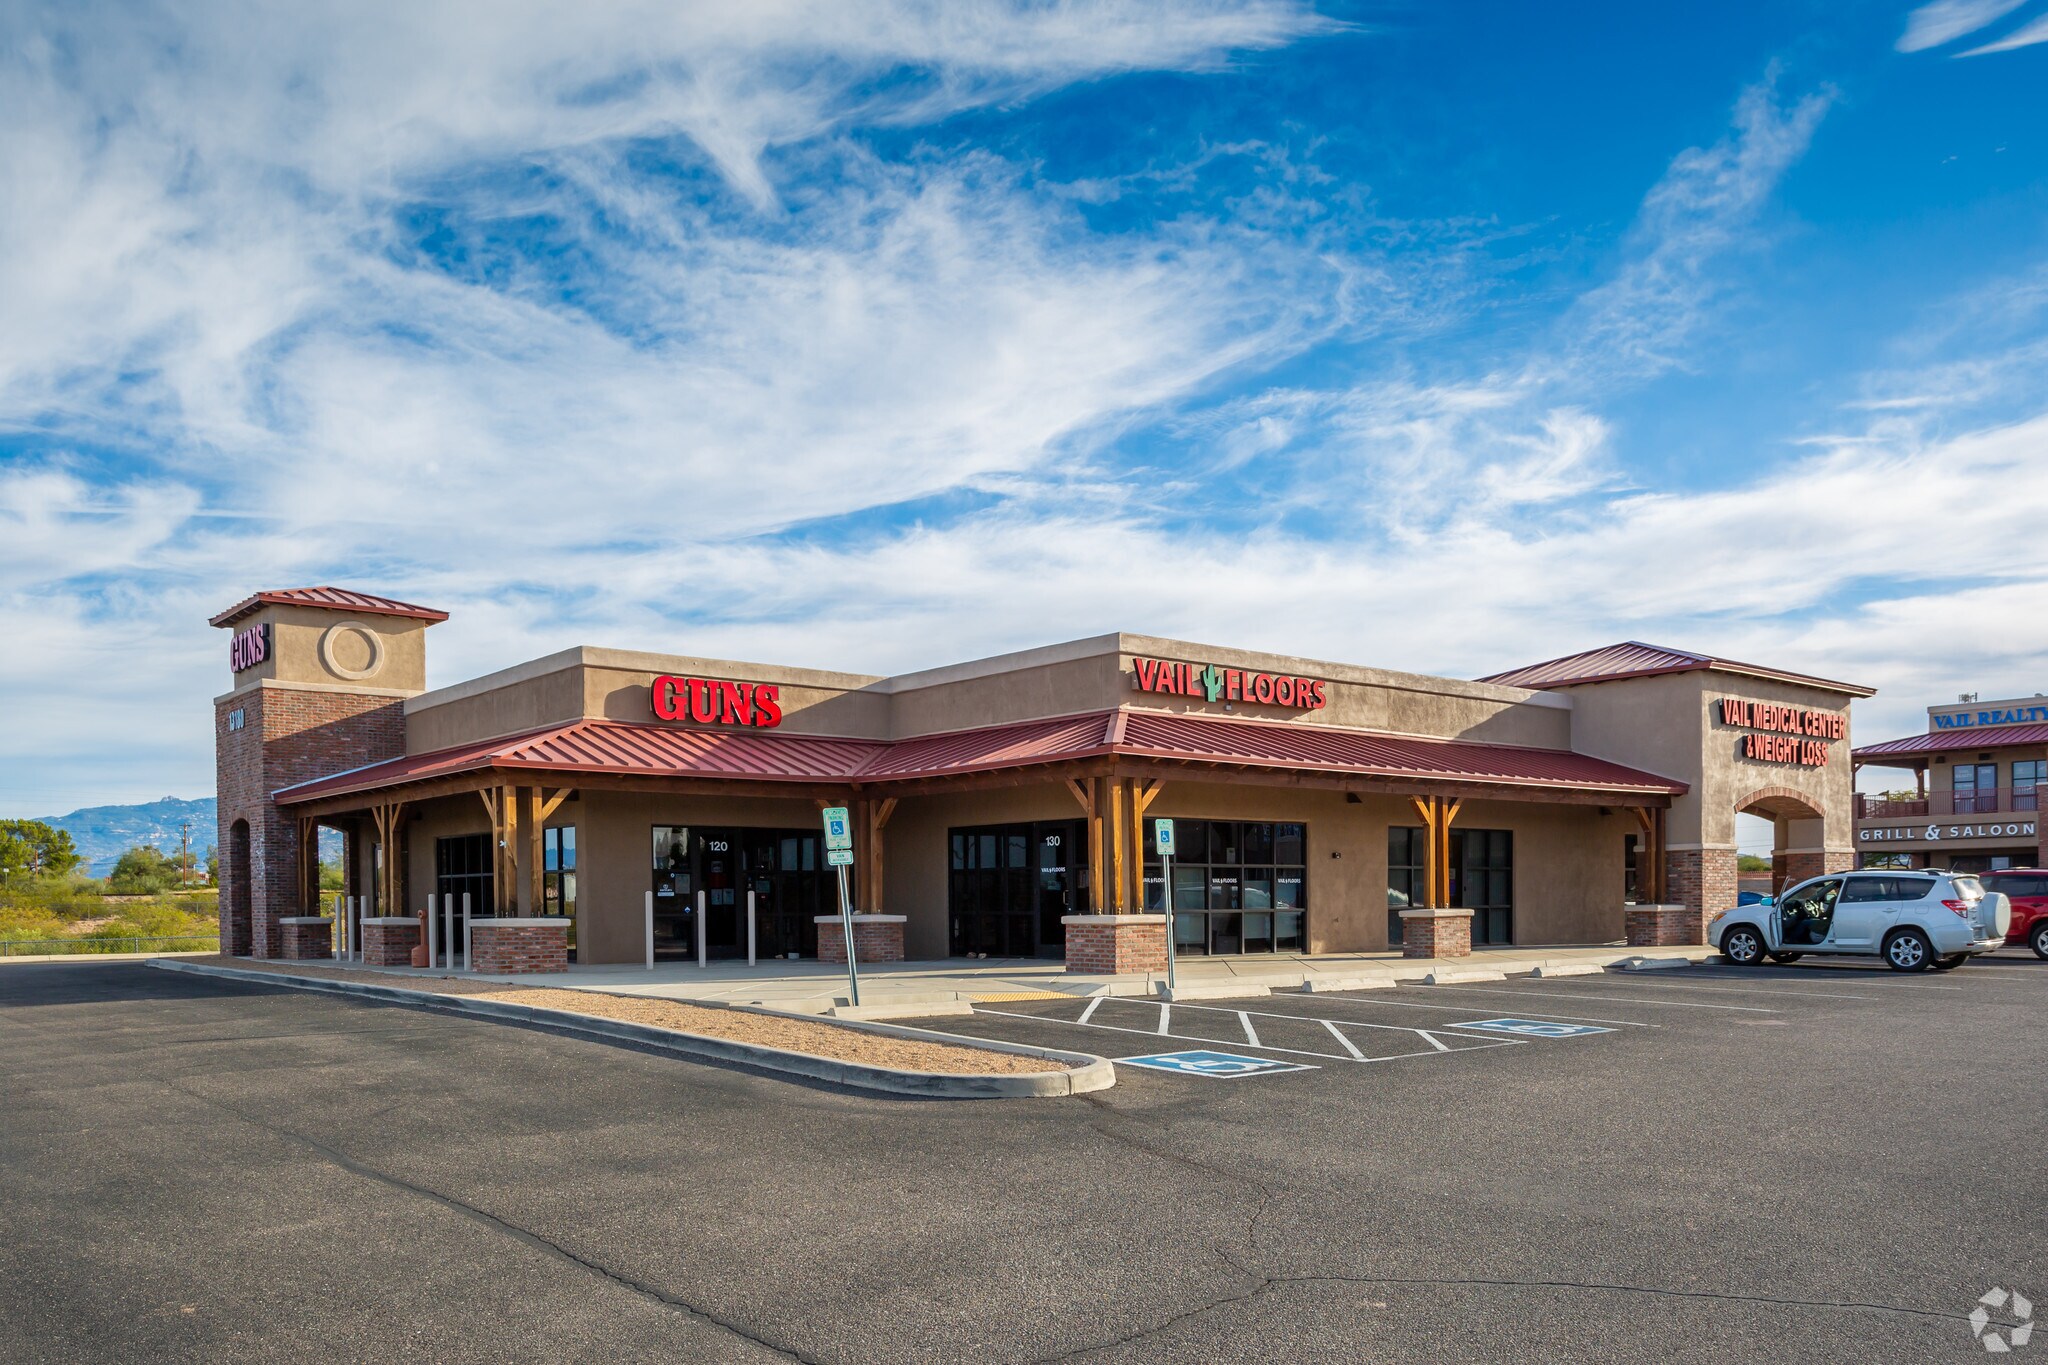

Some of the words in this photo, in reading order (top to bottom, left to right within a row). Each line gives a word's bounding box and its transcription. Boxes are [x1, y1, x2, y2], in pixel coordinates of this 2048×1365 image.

[230, 624, 267, 673] GUNS
[1133, 657, 1201, 695] VAIL
[1224, 669, 1328, 709] FLOORS
[652, 675, 783, 728] GUNS
[1722, 697, 1751, 728] VAIL
[1753, 703, 1803, 735] MEDICAL
[1804, 711, 1847, 740] CENTER
[1933, 713, 1975, 729] VAIL
[1801, 740, 1829, 767] LOSS
[1046, 835, 1060, 846] 130
[1860, 829, 1915, 840] GRILL
[1924, 824, 1940, 840] &
[1949, 823, 2035, 838] SALOON
[709, 841, 728, 851] 120
